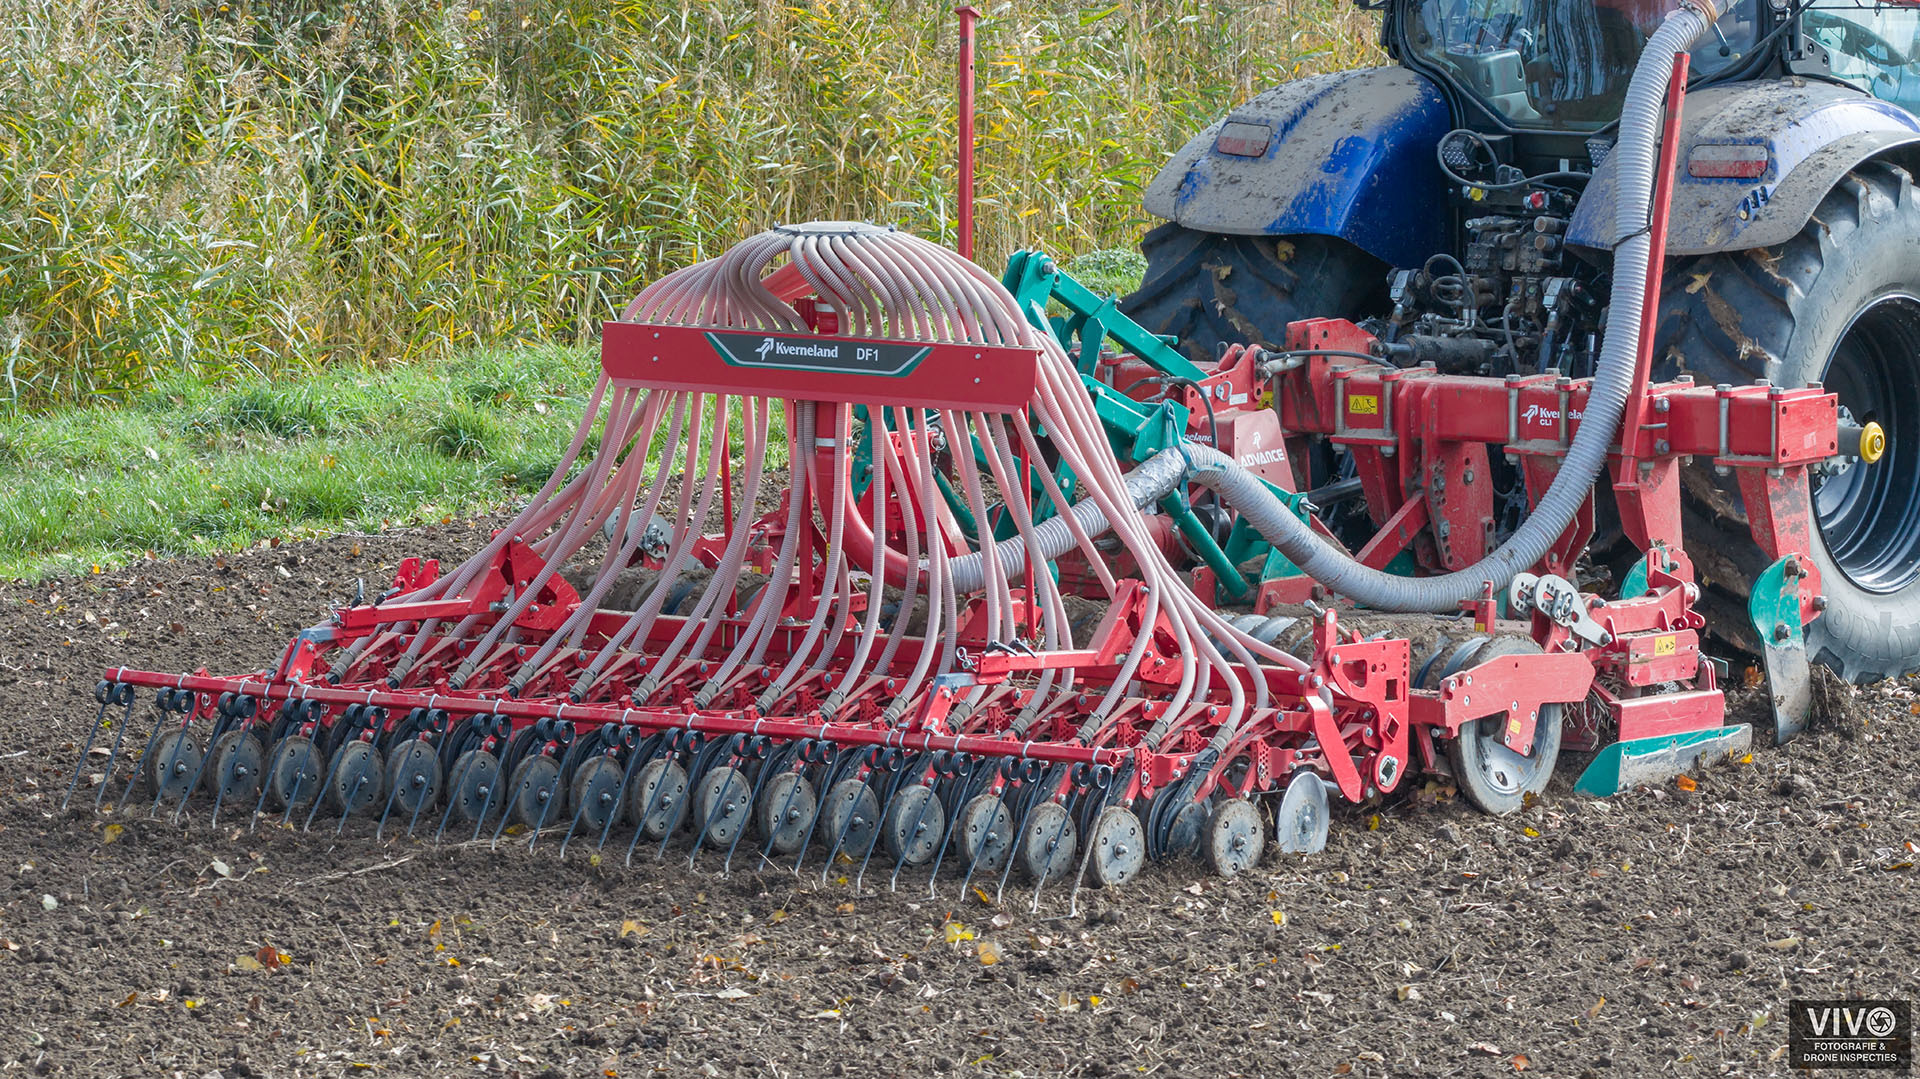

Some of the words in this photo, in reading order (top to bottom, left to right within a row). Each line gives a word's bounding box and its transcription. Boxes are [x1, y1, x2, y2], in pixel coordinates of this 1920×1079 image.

[775, 341, 839, 358] Kverneland
[856, 347, 879, 361] DF1
[1240, 448, 1286, 467] ADVANCE
